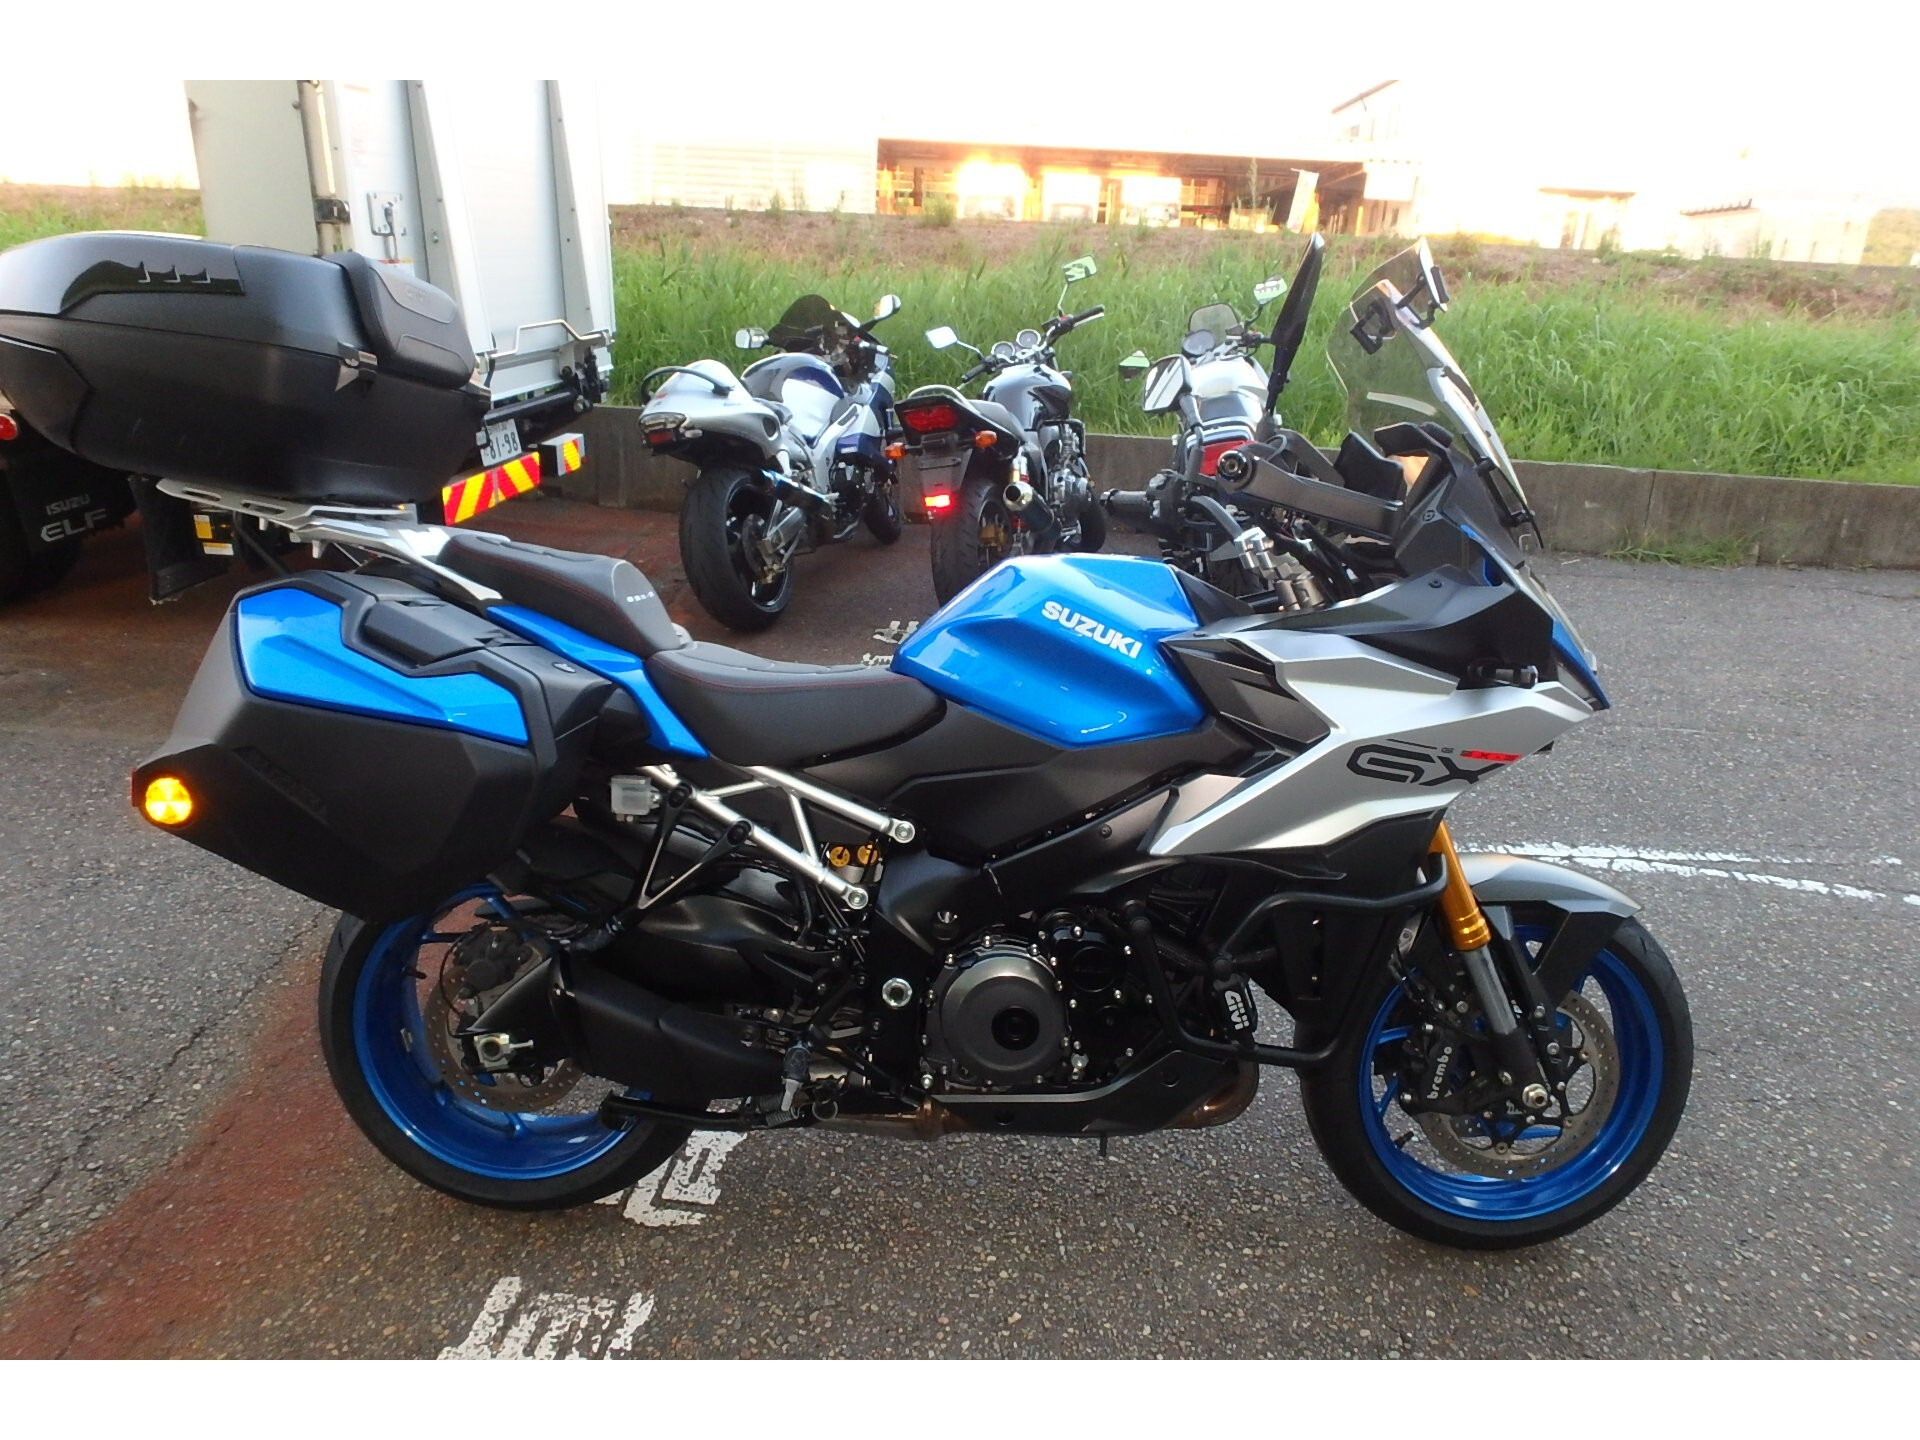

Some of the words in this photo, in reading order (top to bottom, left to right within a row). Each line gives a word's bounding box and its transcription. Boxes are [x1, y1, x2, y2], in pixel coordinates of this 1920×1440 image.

[40, 508, 108, 542] ELF
[45, 493, 91, 515] ISUZU
[1041, 601, 1143, 659] SUZUKI
[1427, 1046, 1453, 1099] brembo
